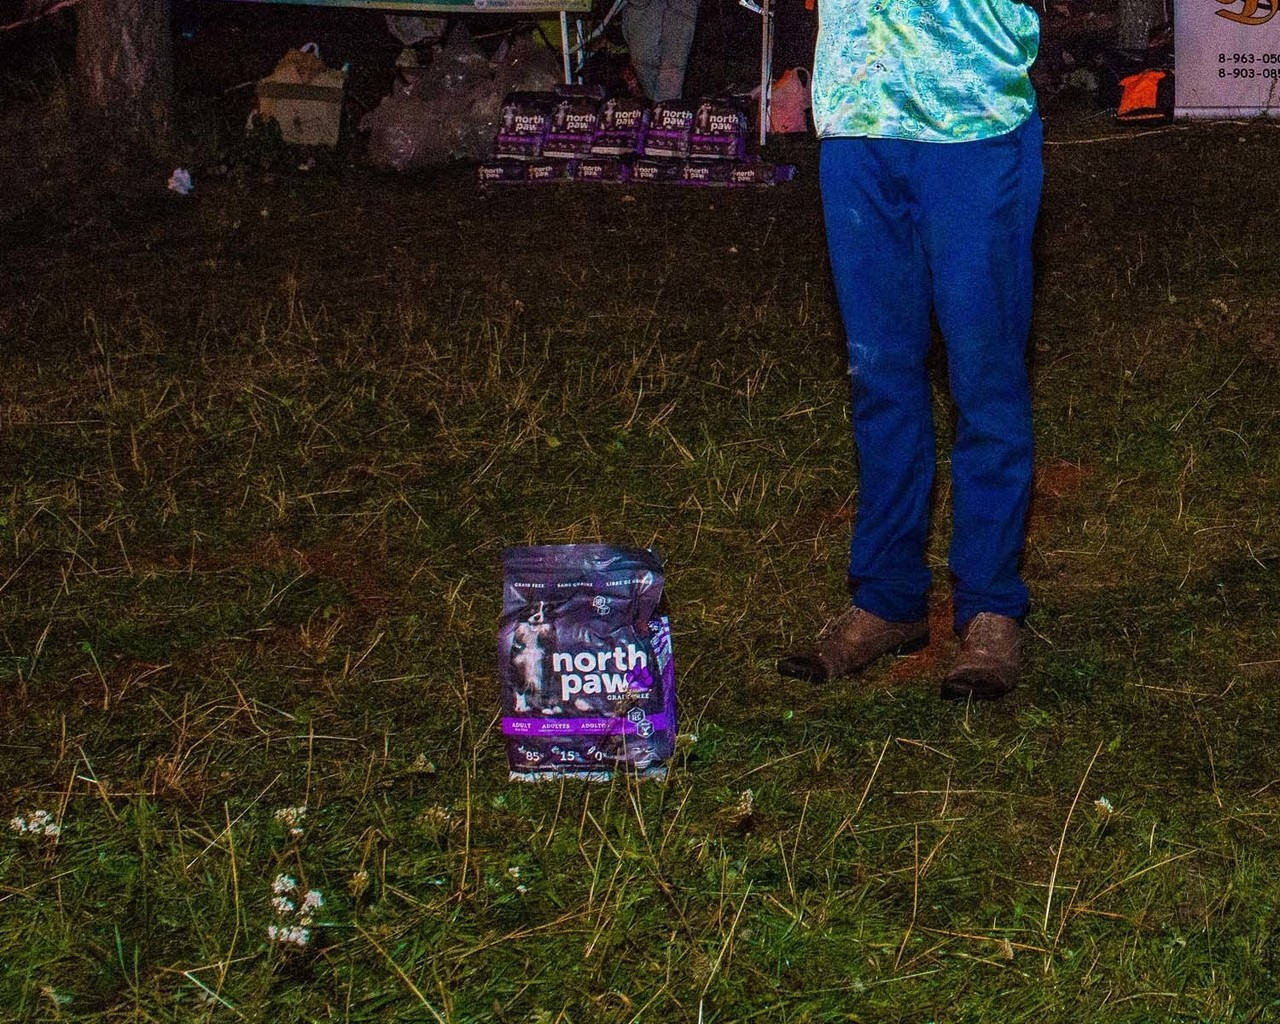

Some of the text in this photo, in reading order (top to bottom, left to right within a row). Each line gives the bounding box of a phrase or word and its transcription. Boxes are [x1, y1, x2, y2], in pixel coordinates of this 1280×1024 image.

[566, 113, 596, 123] north
[615, 109, 641, 118] north
[662, 109, 693, 119] north
[515, 115, 544, 124] north
[615, 117, 635, 126] paw
[662, 117, 687, 126] paw
[710, 115, 739, 123] north
[515, 123, 537, 132] paw
[567, 121, 589, 130] paw
[710, 122, 732, 131] paw
[552, 644, 648, 673] north
[561, 673, 629, 701] paw
